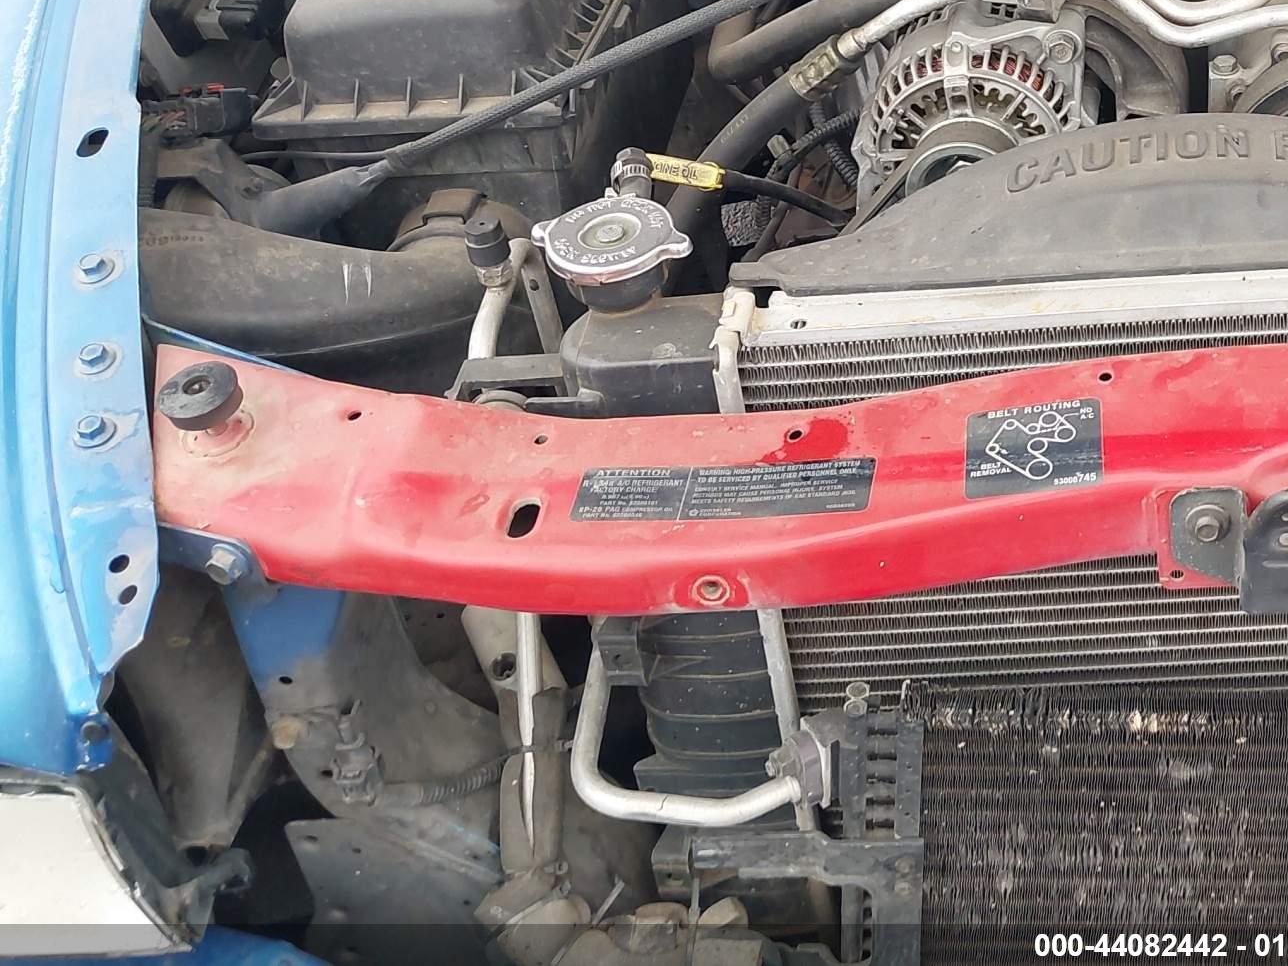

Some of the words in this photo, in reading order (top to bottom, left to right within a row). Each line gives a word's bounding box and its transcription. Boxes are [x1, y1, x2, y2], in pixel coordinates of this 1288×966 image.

[1005, 125, 1249, 194] CAUTION
[682, 165, 697, 180] OIL
[988, 409, 1018, 419] BELT
[1024, 400, 1081, 414] ROUTING
[787, 462, 833, 472] REFRIGERANT
[834, 460, 861, 468] SYSTEM
[763, 473, 798, 481] QUALIFIED
[799, 470, 837, 478] PERSONNEL
[970, 468, 1012, 478] REMOVAL
